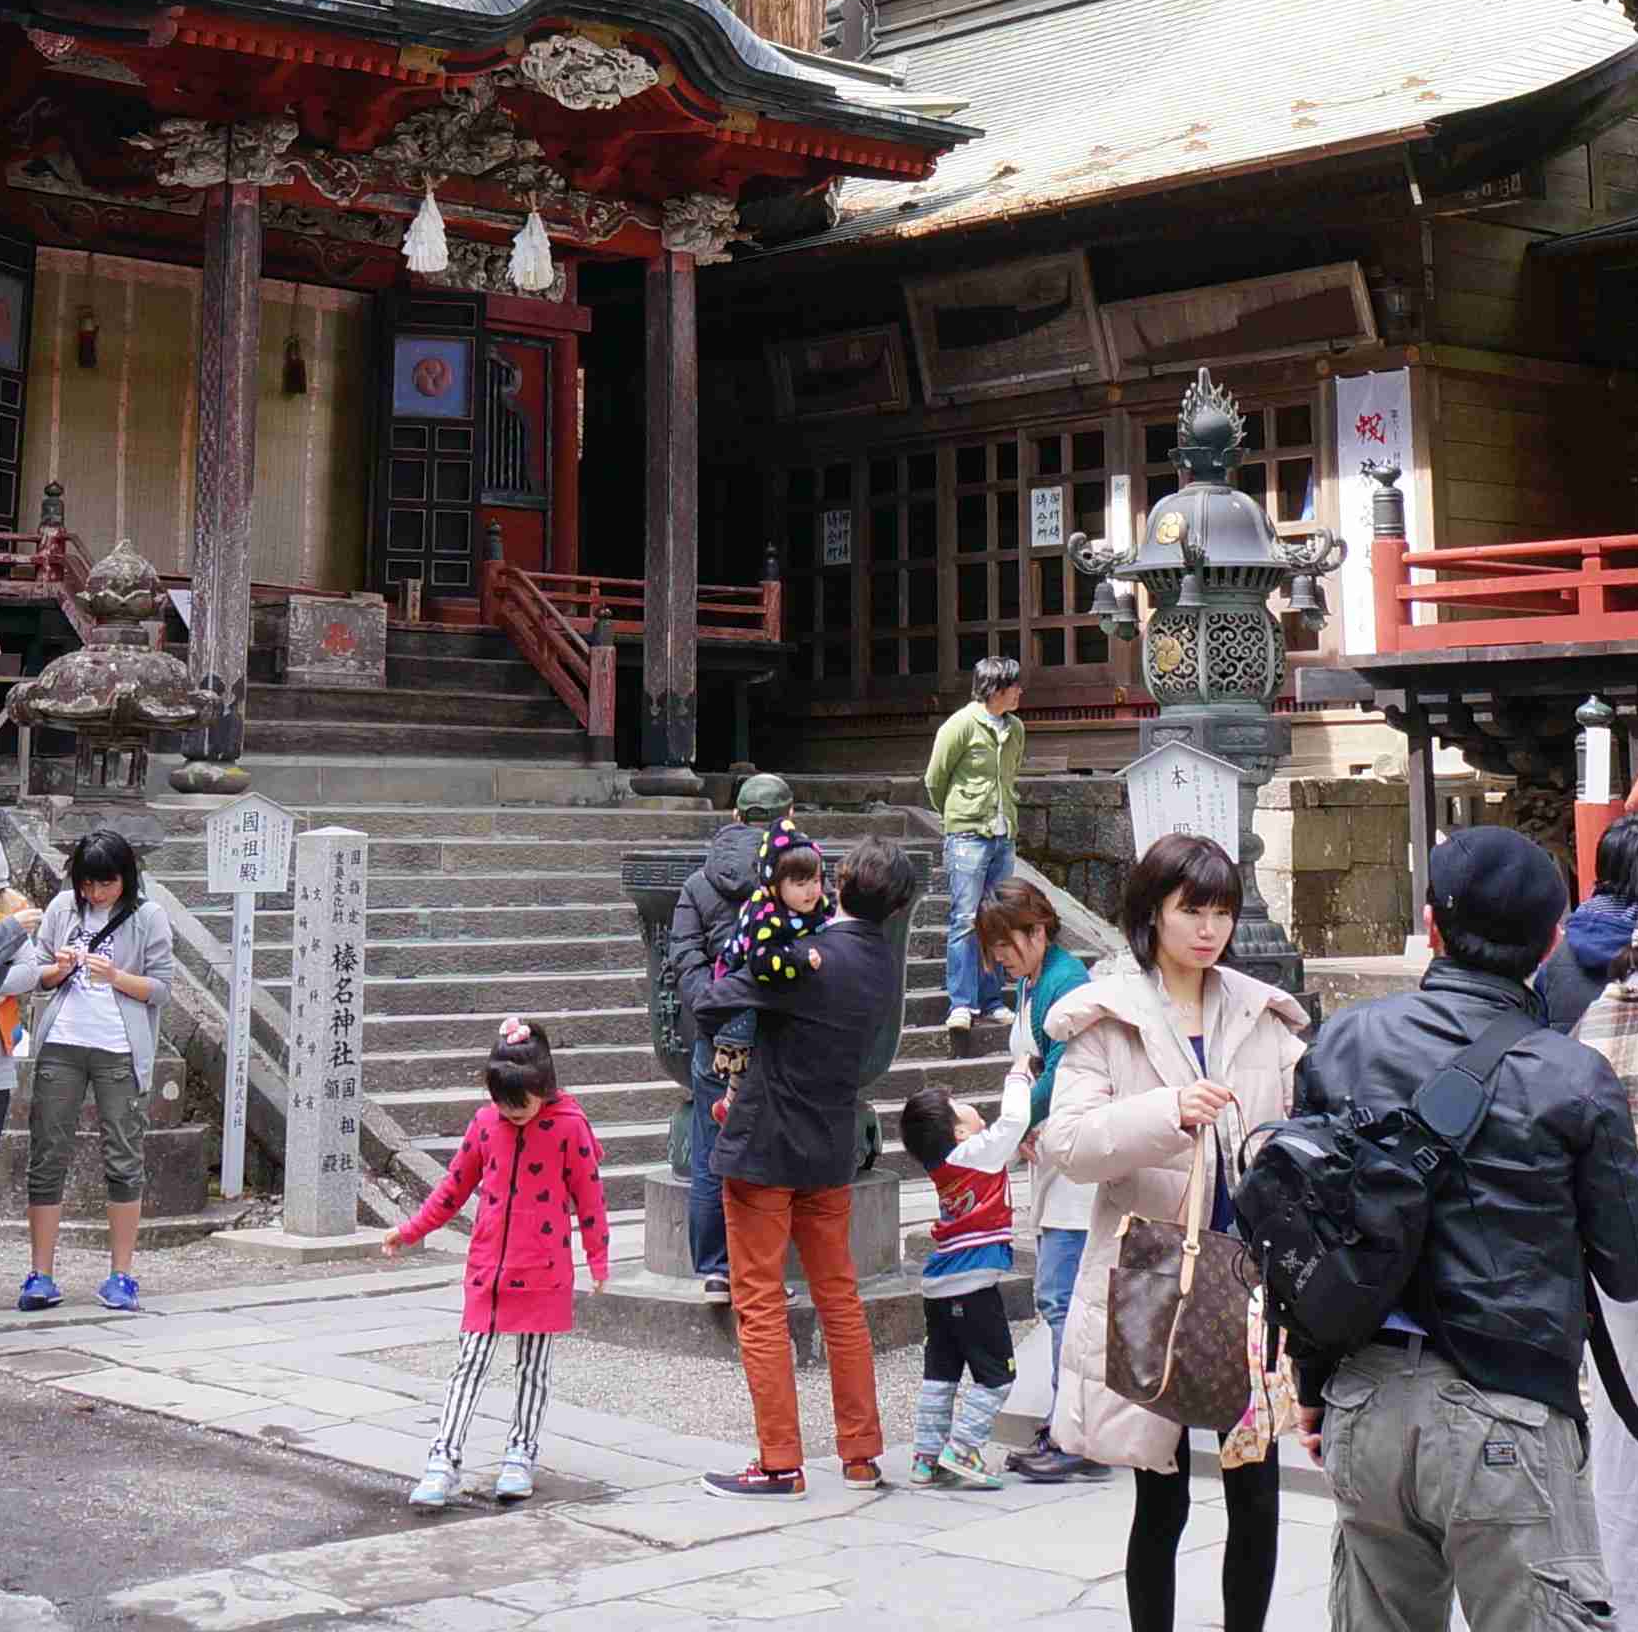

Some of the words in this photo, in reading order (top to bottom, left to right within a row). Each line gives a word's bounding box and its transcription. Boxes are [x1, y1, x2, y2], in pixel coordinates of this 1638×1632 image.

[239, 810, 260, 882] 國祖殿
[331, 849, 345, 924] 重要文化財
[347, 849, 362, 925] 国指定
[329, 941, 359, 1068] 榛名神社
[338, 1077, 356, 1171] 国祖社
